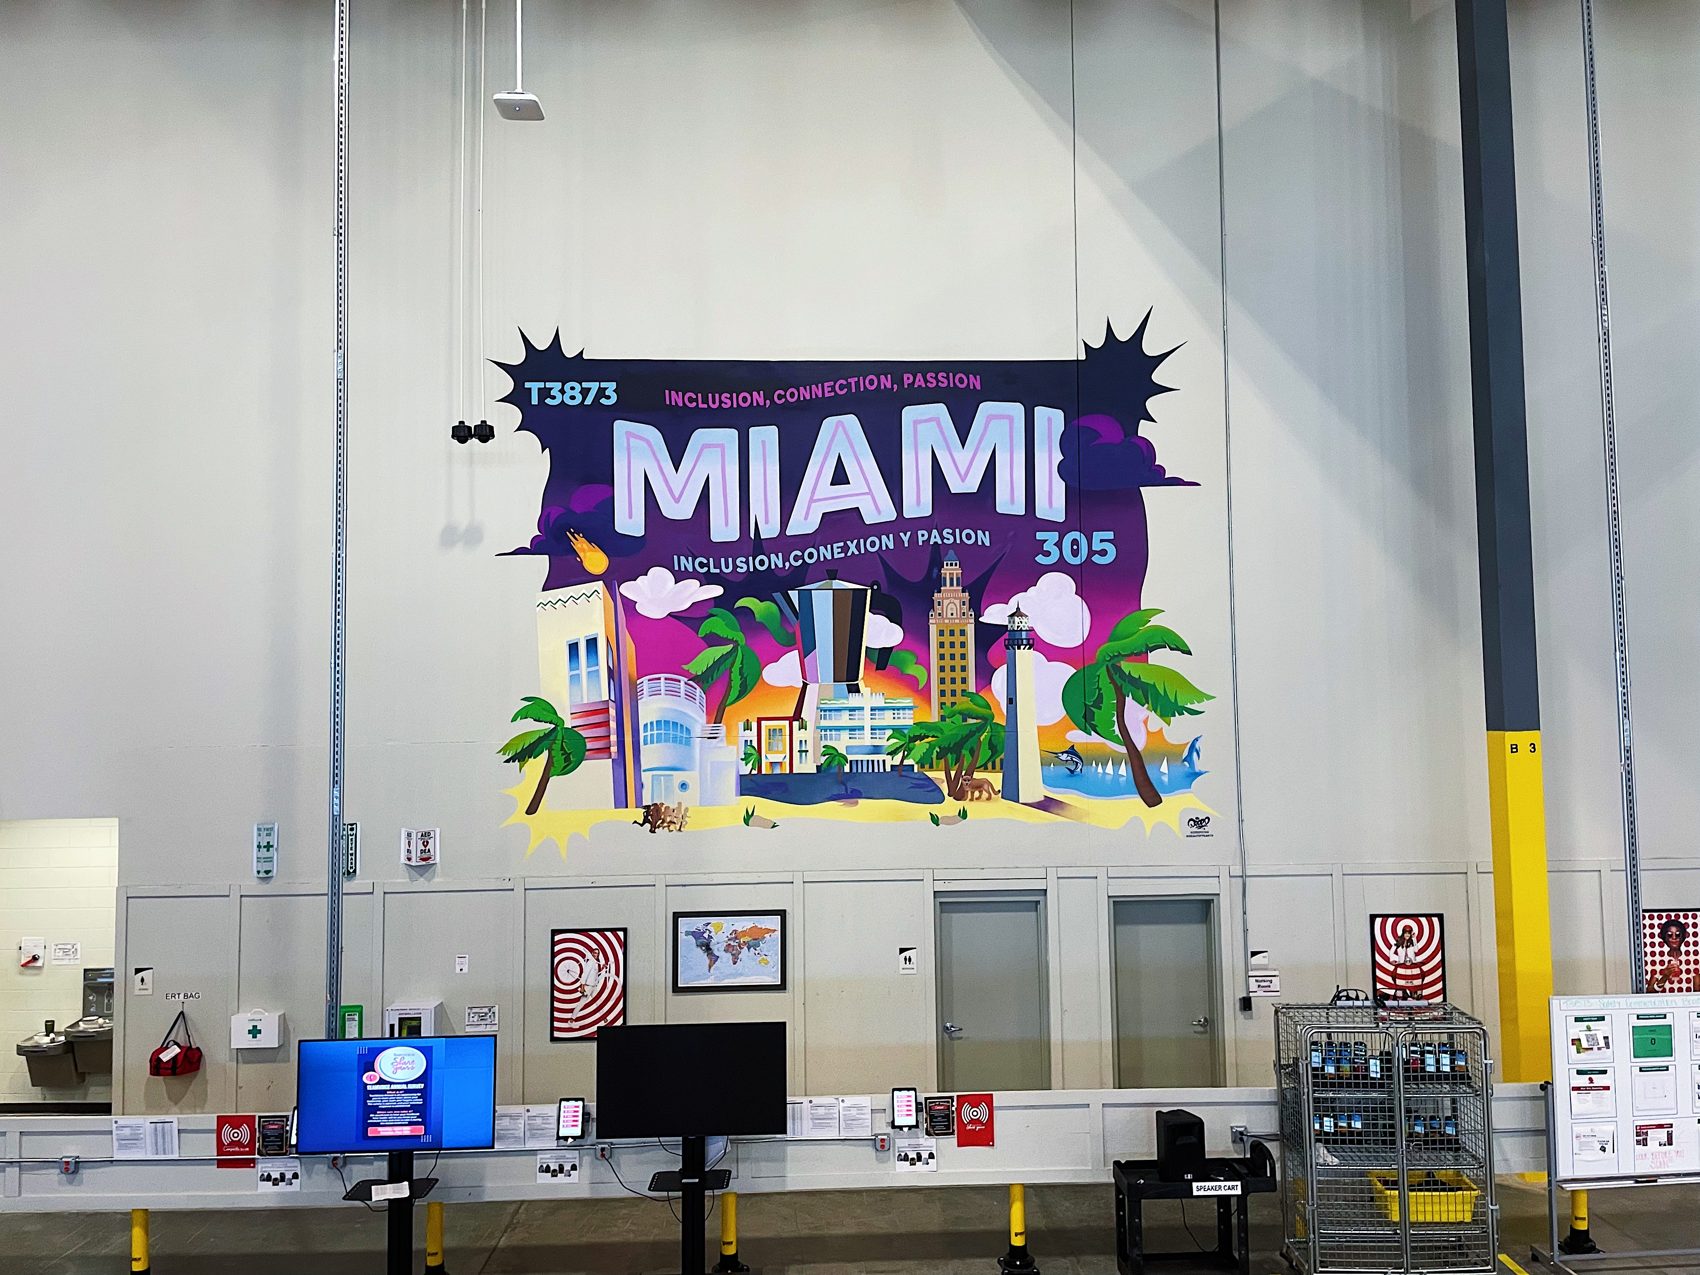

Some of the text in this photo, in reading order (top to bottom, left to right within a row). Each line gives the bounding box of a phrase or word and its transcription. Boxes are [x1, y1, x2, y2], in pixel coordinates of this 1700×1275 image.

[524, 381, 618, 406] T3873
[664, 372, 981, 409] INCLUSION, CONNECTION, PASSION
[613, 401, 1066, 543] MIAMI
[899, 531, 912, 548] Y
[917, 528, 990, 547] PASION
[1034, 531, 1117, 565] 305
[1510, 742, 1537, 754] B 3
[165, 992, 201, 1000] ERT BAG
[1195, 1184, 1223, 1192] SPEAKER
